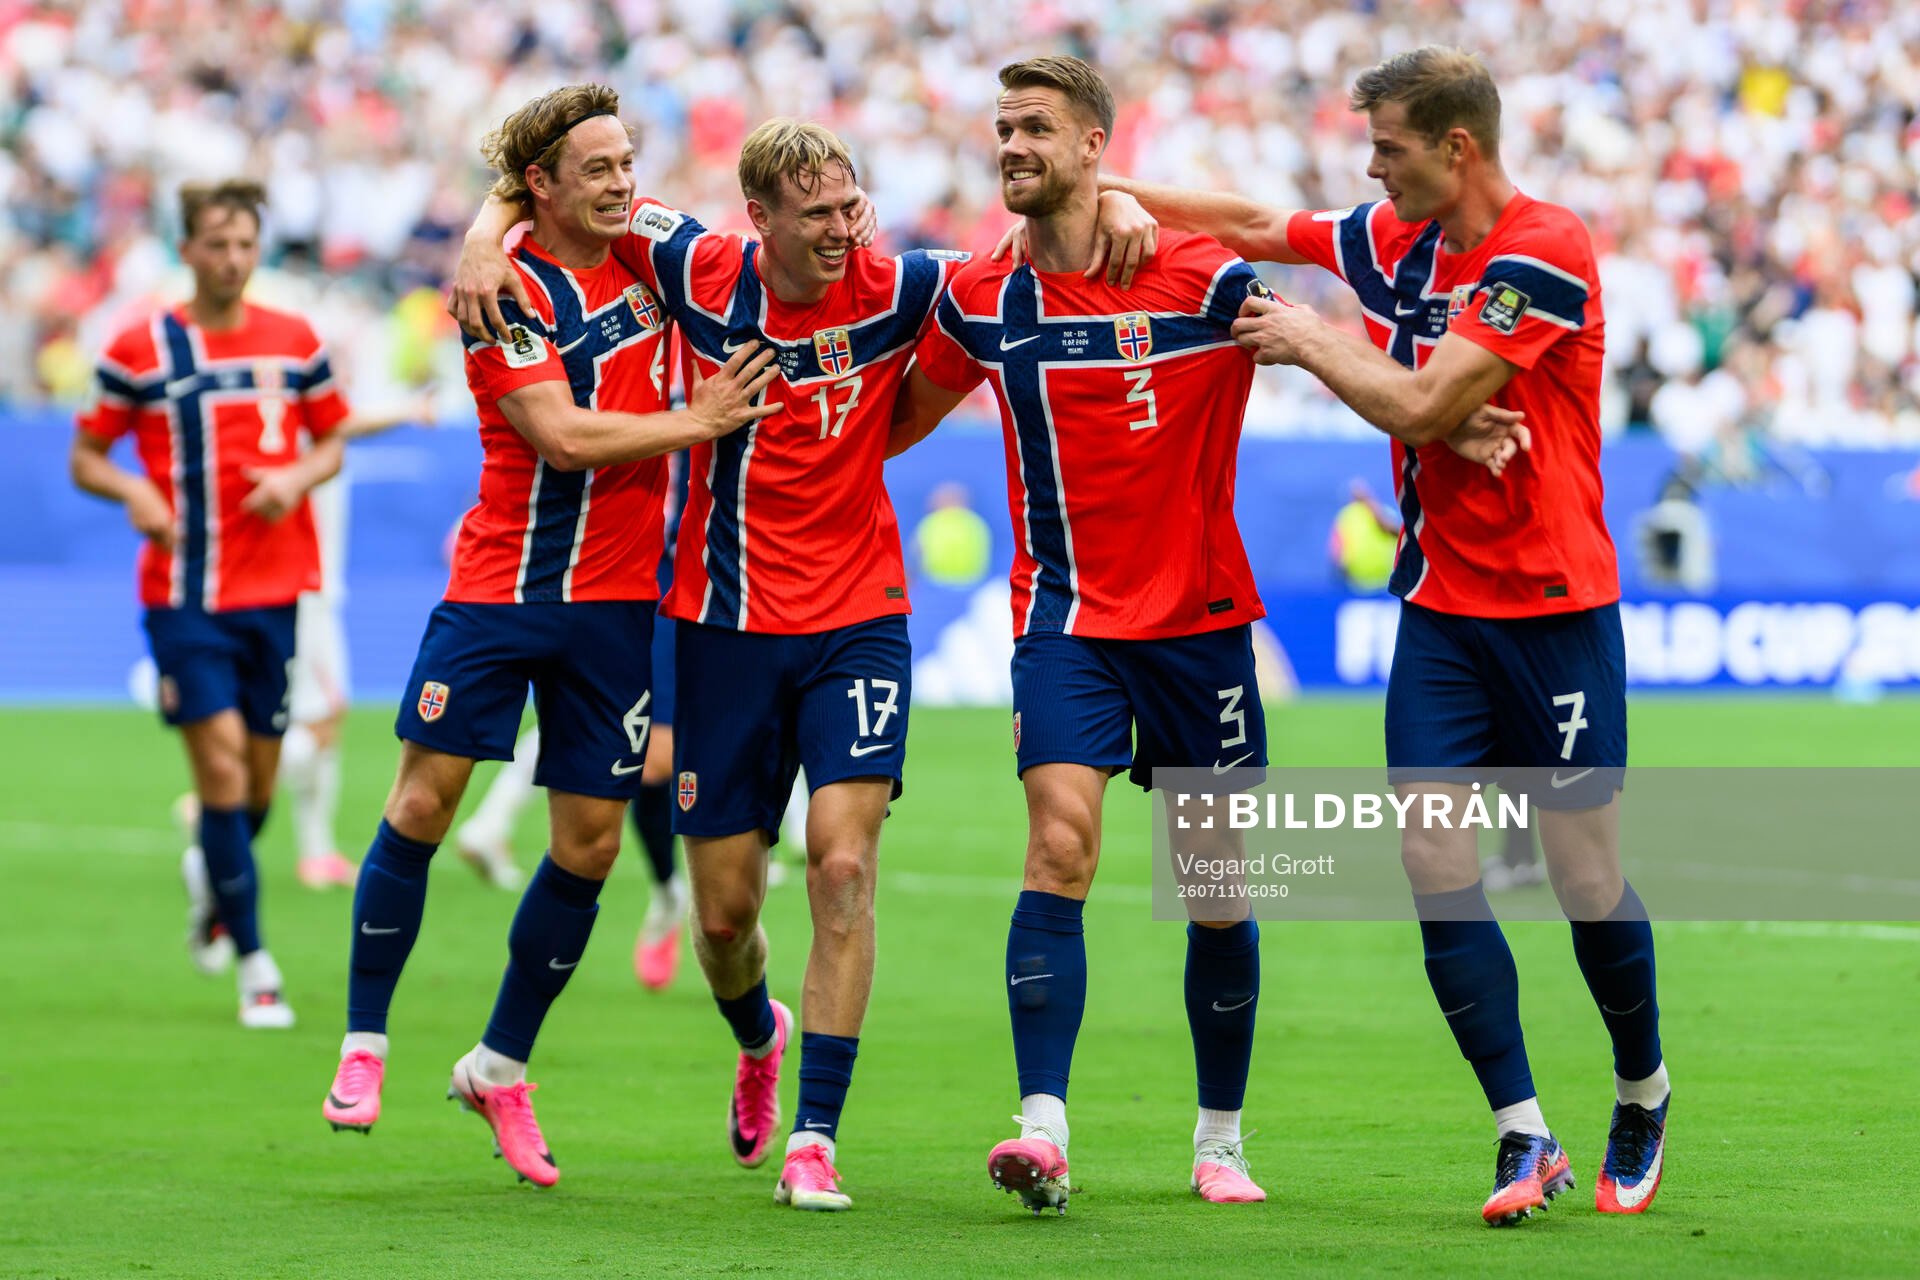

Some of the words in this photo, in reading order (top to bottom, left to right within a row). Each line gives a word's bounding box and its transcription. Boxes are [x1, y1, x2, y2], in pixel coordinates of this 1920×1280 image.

[811, 375, 863, 441] 17
[1123, 367, 1159, 432] 3
[622, 688, 651, 753] 6
[847, 678, 899, 737] 17
[1217, 684, 1247, 749] 3
[1552, 690, 1589, 761] 7
